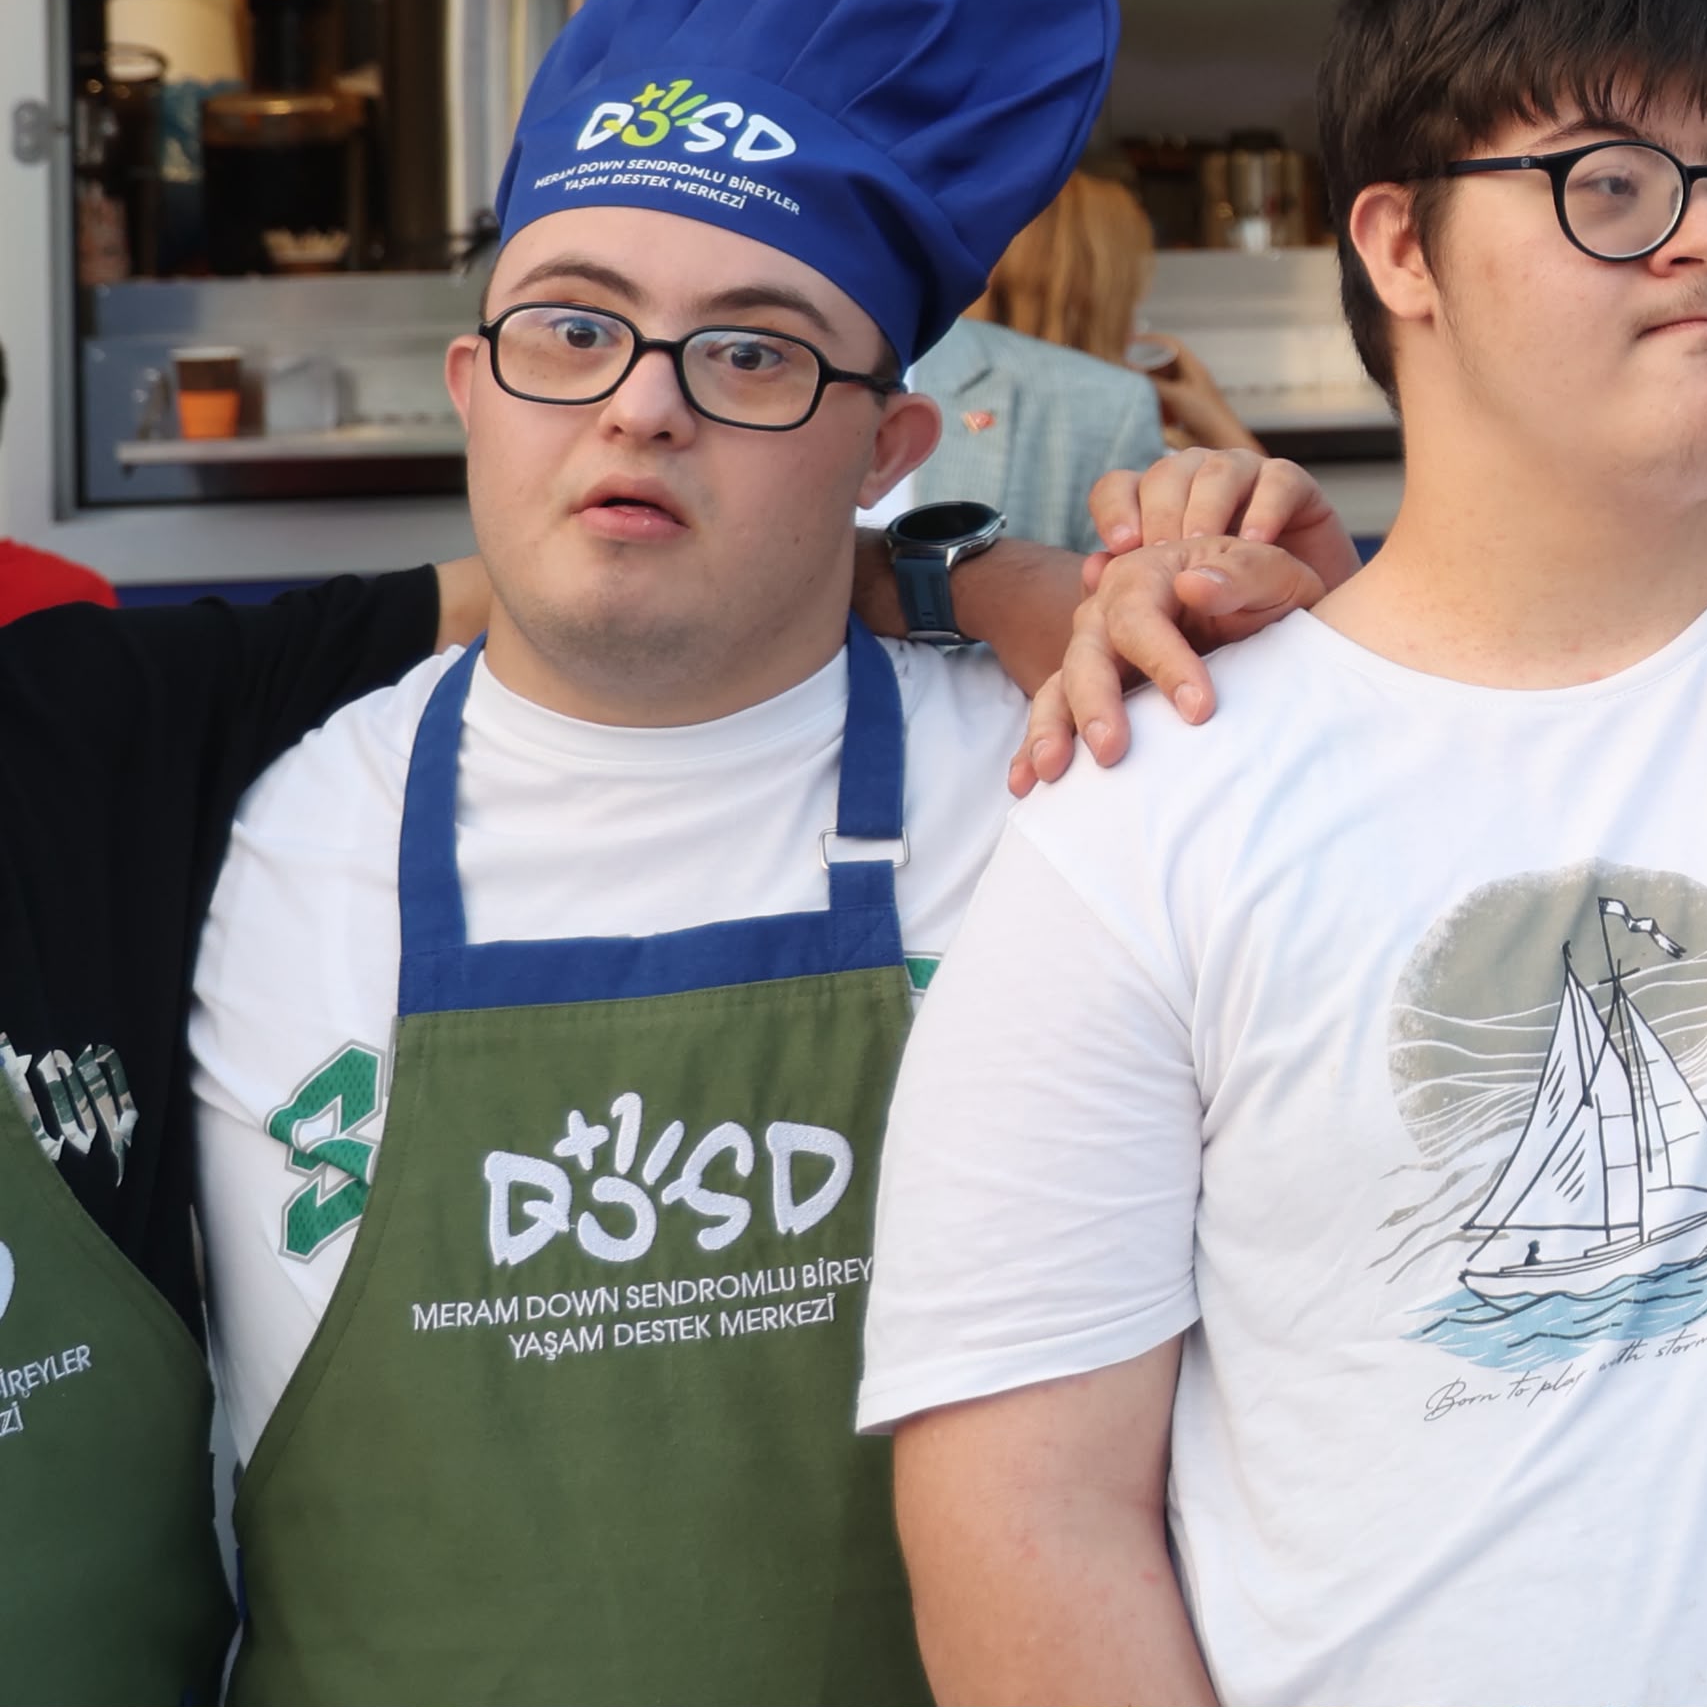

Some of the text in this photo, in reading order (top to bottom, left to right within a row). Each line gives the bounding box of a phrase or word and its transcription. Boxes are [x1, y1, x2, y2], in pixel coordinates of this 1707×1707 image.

[534, 159, 801, 215] MERAM DOWN SENDROMLU BİREYLER
[564, 173, 748, 210] YAŞAM DESTEK MERKEZİ
[412, 1294, 519, 1332] MERAM
[526, 1285, 619, 1320] DOWN
[626, 1265, 796, 1311] SENDROMLU
[508, 1292, 836, 1362] YAŞAM DESTEK MERKEZİ
[1424, 1375, 1501, 1422] Born
[1506, 1370, 1543, 1400] to
